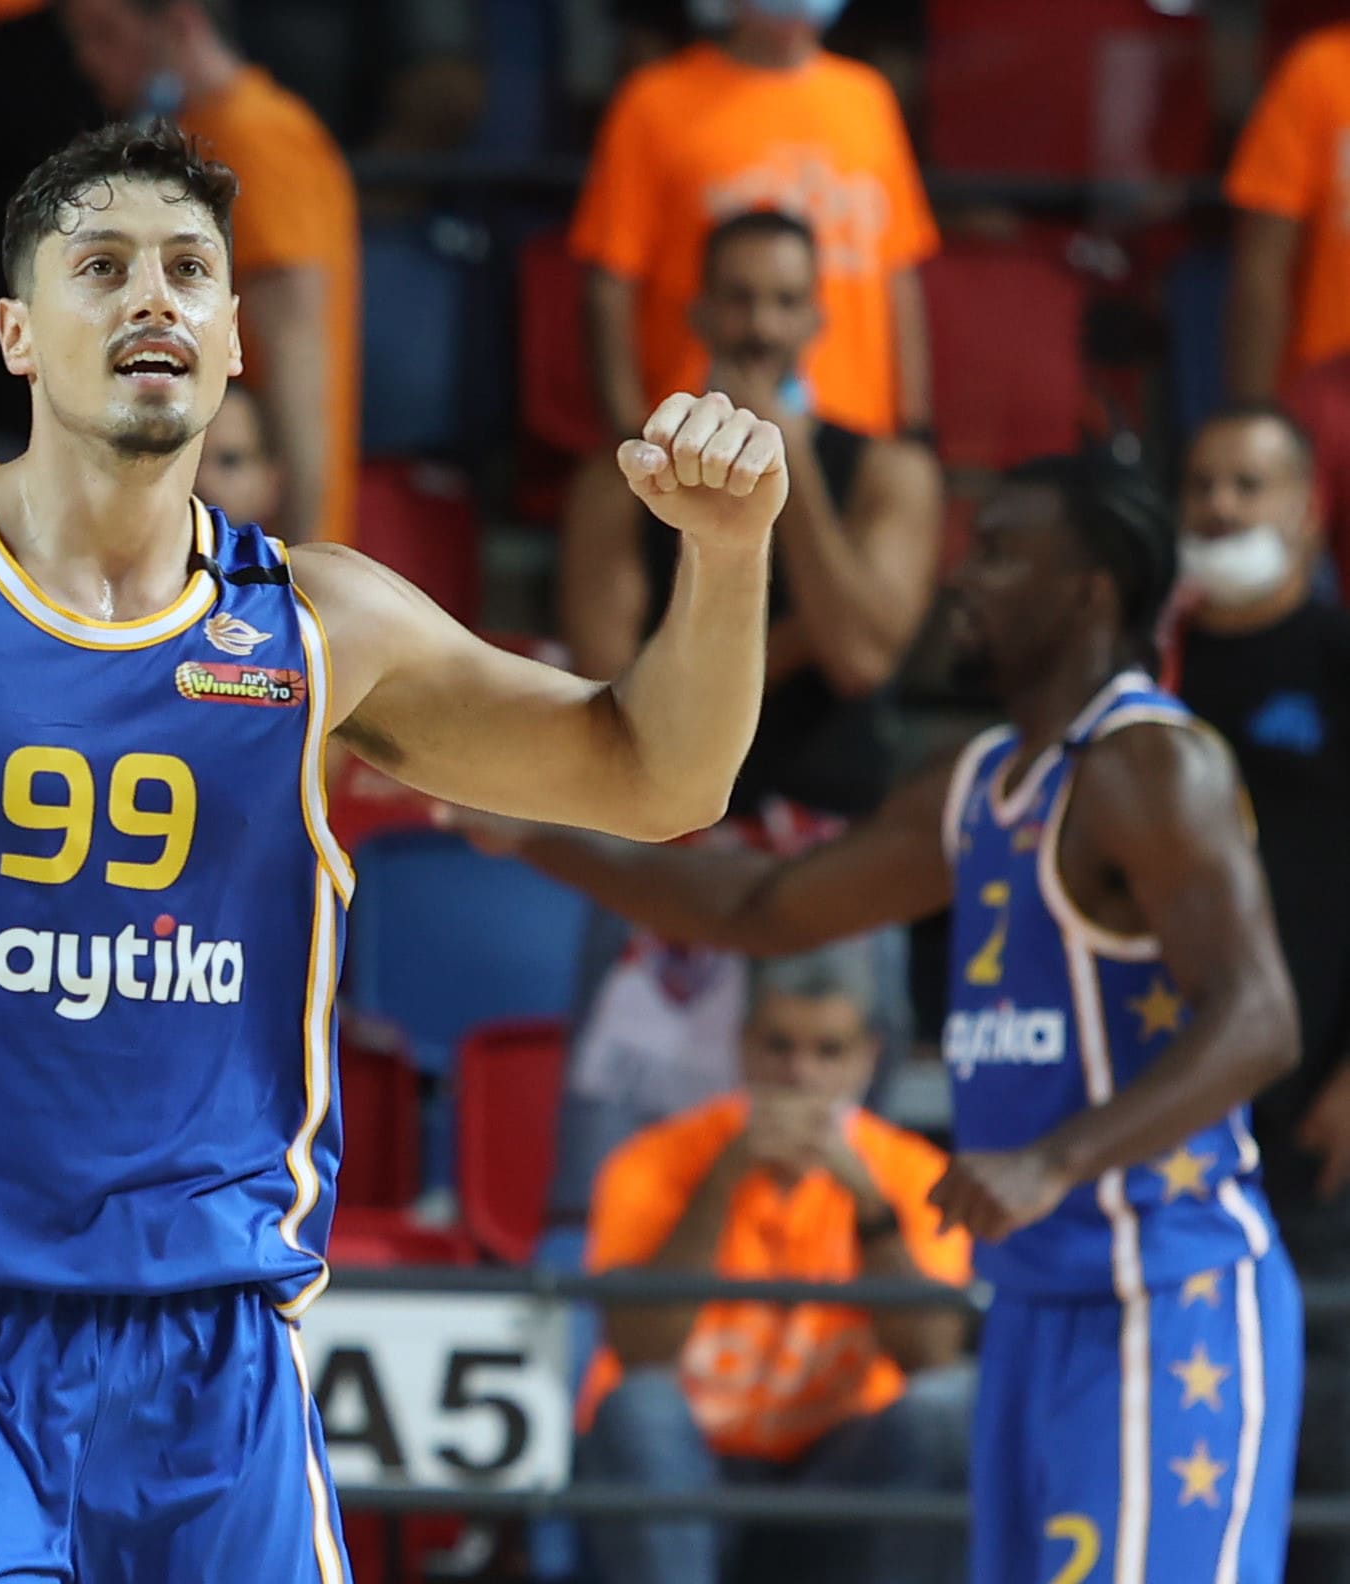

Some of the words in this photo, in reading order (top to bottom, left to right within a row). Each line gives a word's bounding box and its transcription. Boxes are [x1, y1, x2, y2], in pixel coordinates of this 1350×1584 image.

[190, 672, 269, 698] Winner
[0, 745, 197, 891] 99
[964, 881, 1010, 985] 2
[316, 1350, 528, 1468] A5
[1045, 1513, 1101, 1584] 2
